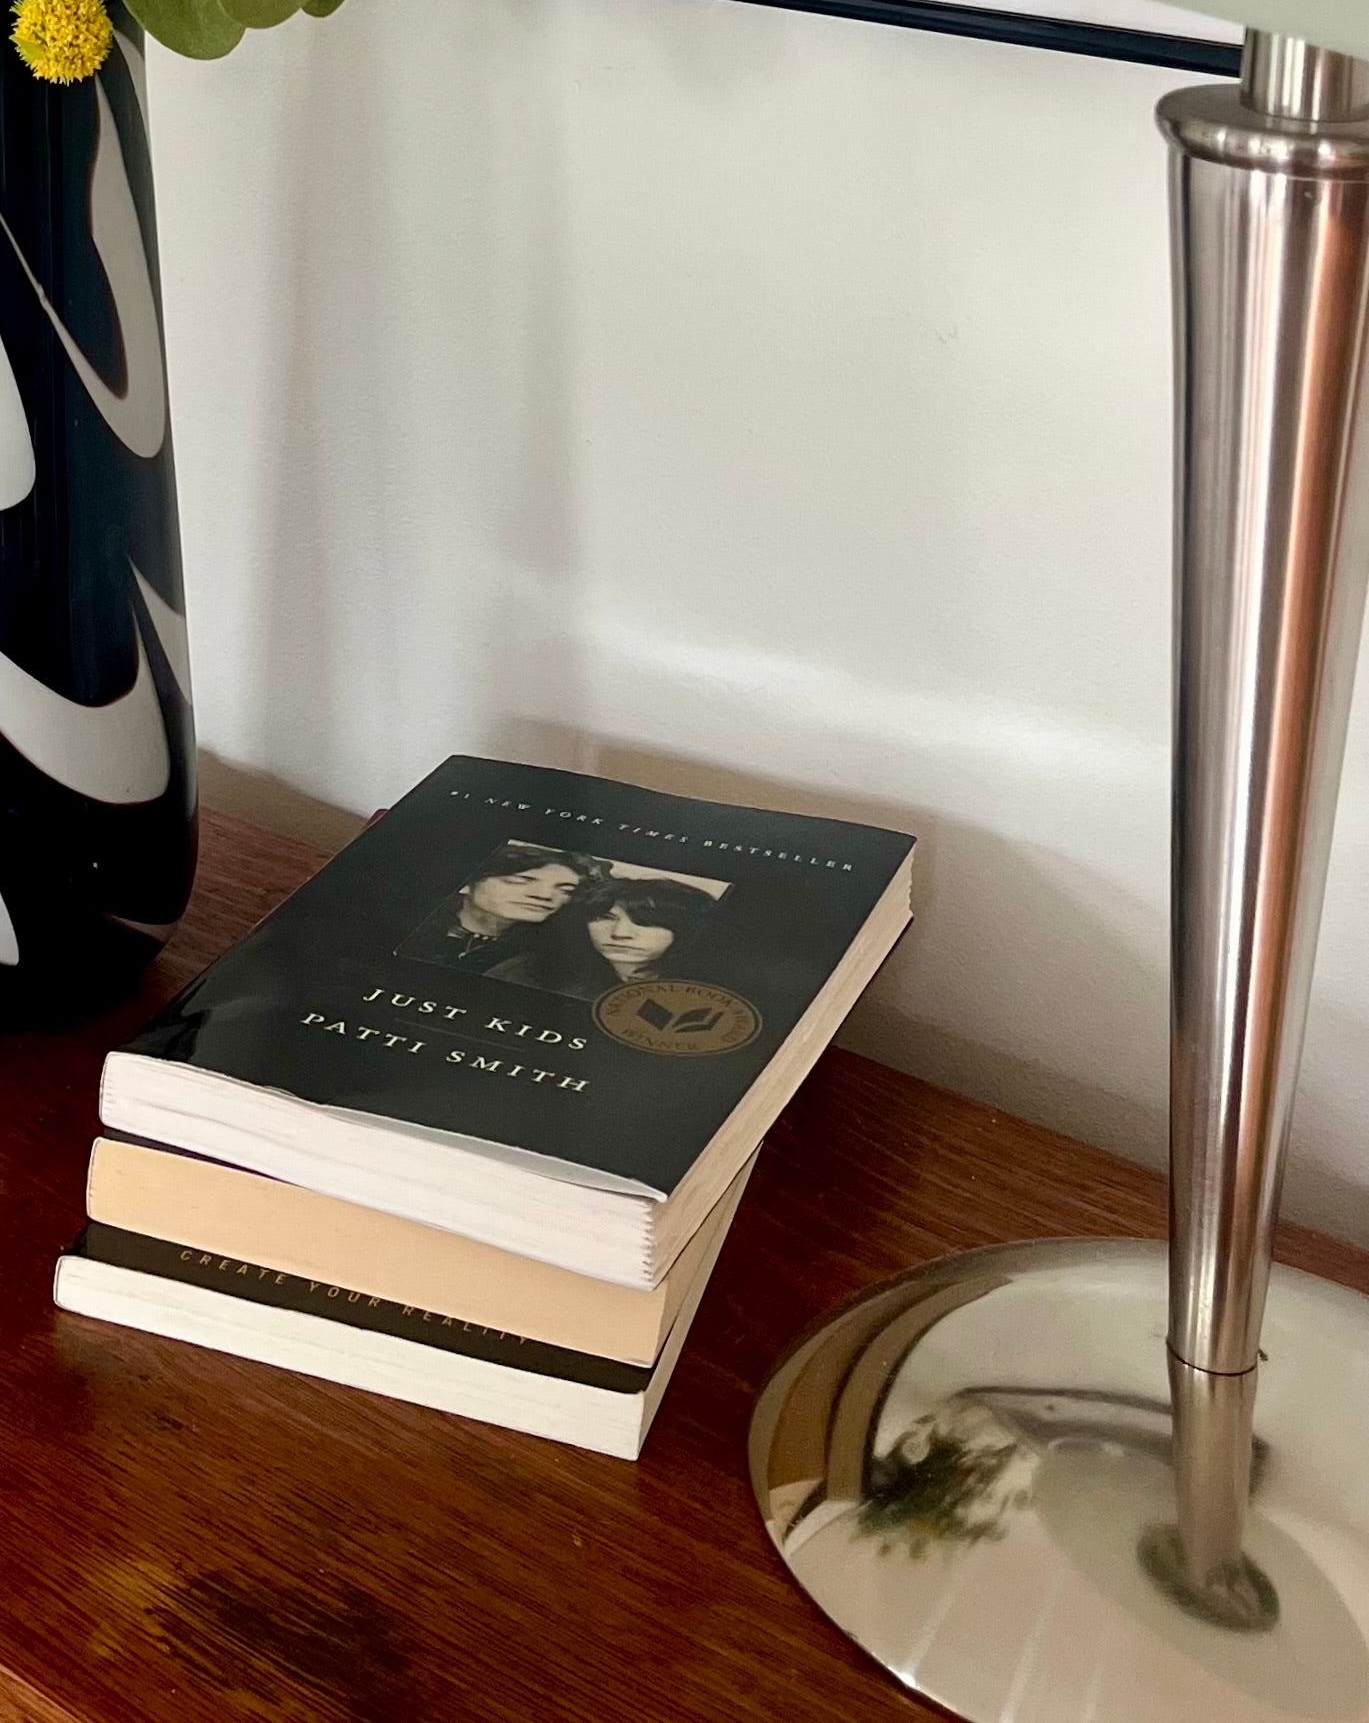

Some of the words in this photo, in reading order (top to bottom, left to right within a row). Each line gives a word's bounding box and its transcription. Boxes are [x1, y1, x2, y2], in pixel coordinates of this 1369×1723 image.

[484, 797, 531, 810] NEW
[544, 808, 605, 825] YORK
[619, 823, 688, 843] TIMES
[704, 840, 853, 871] BESTSELLER
[300, 1013, 427, 1054] PATTI
[445, 1050, 591, 1093] SMITH
[363, 988, 467, 1021] JUST
[484, 1016, 589, 1051] KIDS
[180, 1250, 288, 1286] CREATE
[308, 1281, 382, 1308] YOUR
